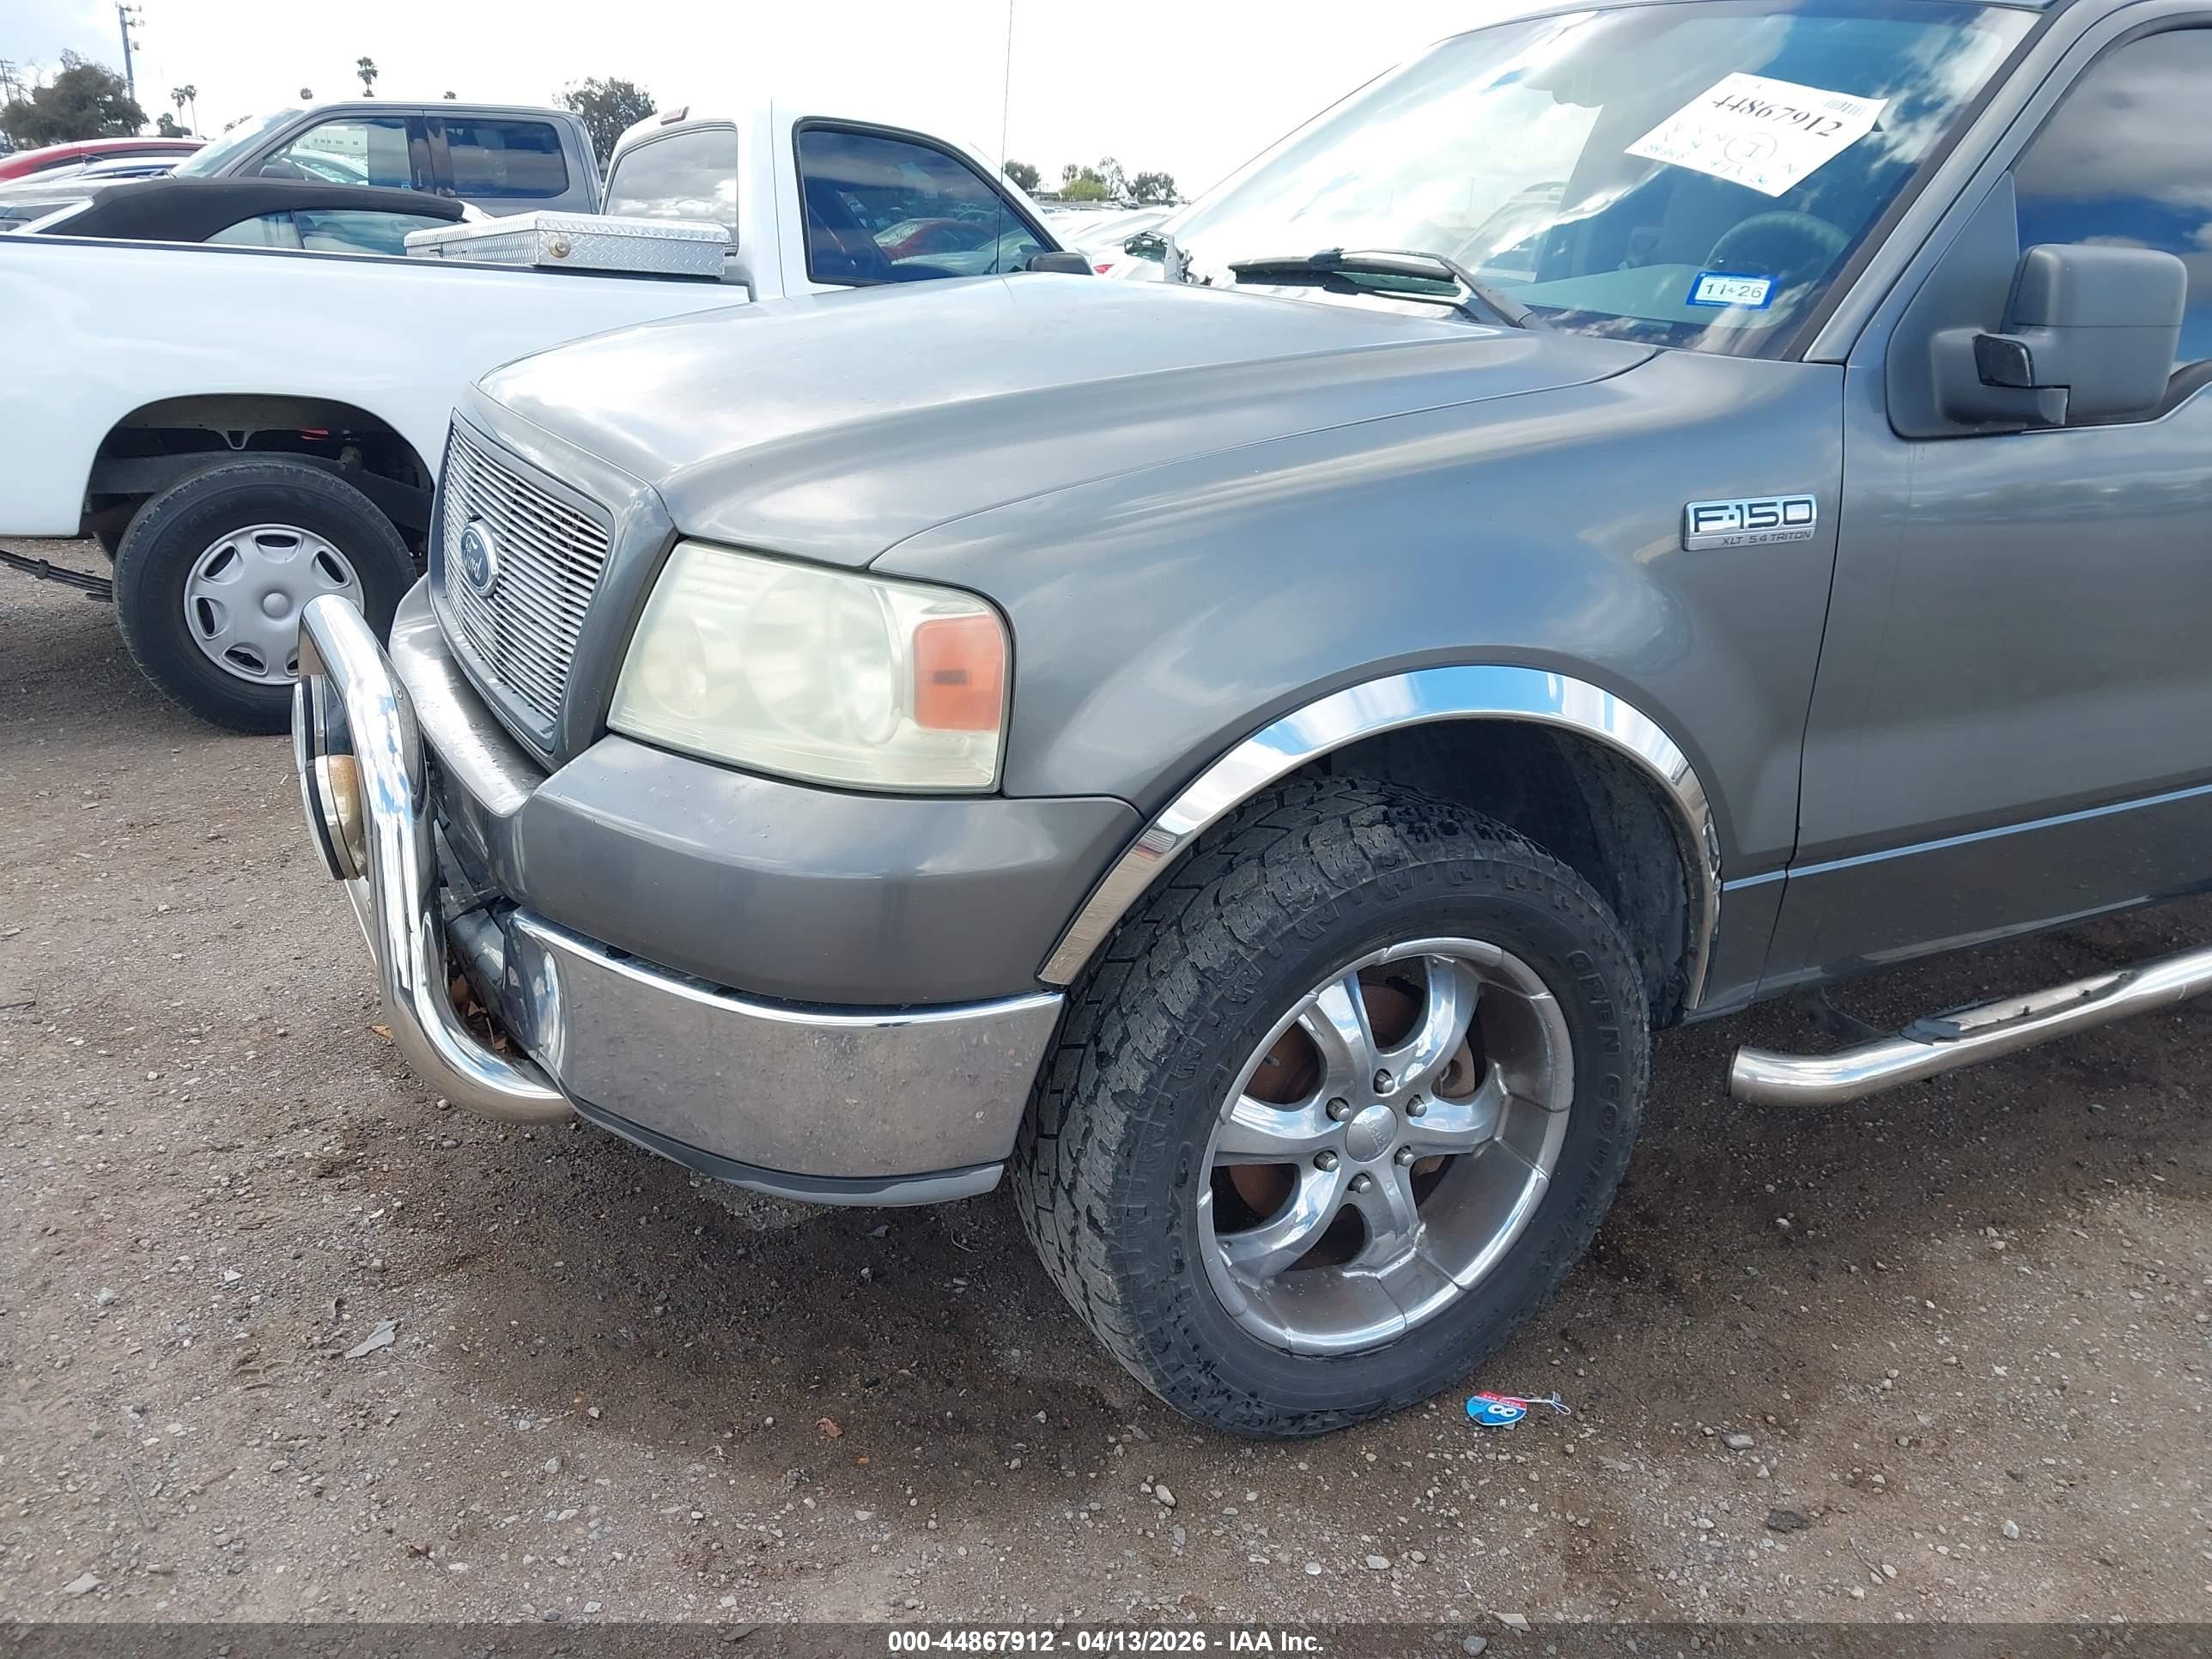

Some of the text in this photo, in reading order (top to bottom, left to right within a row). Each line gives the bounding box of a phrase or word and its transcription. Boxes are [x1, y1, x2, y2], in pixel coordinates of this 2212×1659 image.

[1712, 94, 1844, 137] 44867912
[1694, 500, 1812, 532] F-150
[465, 534, 483, 581] Ford
[1723, 536, 1743, 546] XLT
[1771, 531, 1811, 541] TRITON
[1567, 950, 1622, 1055] OPEN
